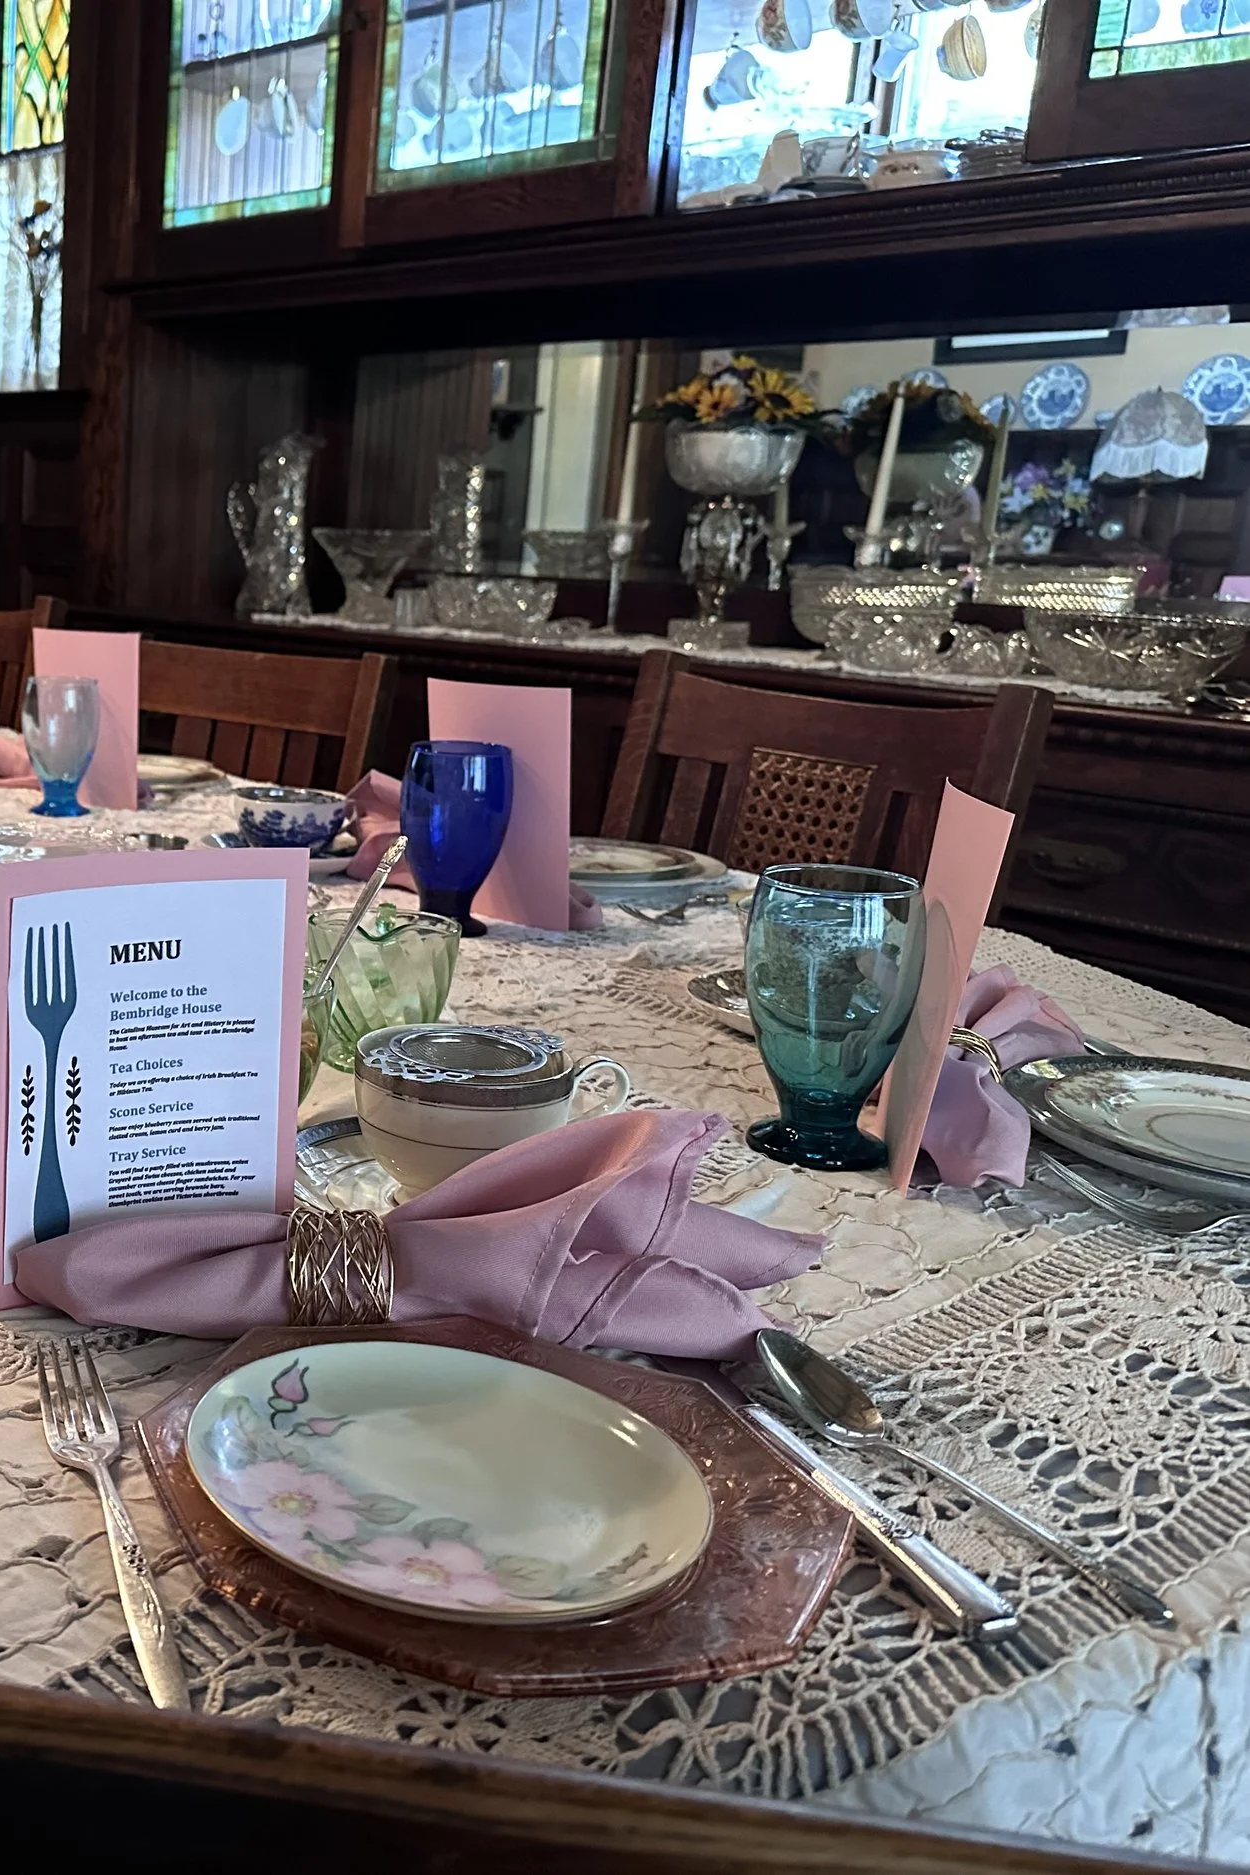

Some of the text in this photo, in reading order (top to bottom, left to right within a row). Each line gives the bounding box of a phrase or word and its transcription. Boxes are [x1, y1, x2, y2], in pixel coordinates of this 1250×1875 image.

[110, 940, 181, 964] MENU
[110, 985, 207, 1003] Welcome to the
[110, 1003, 222, 1021] Bembridge House
[110, 1057, 183, 1074] Tea Choices
[110, 1101, 194, 1118] Scone Service
[110, 1145, 186, 1162] Tray Service
